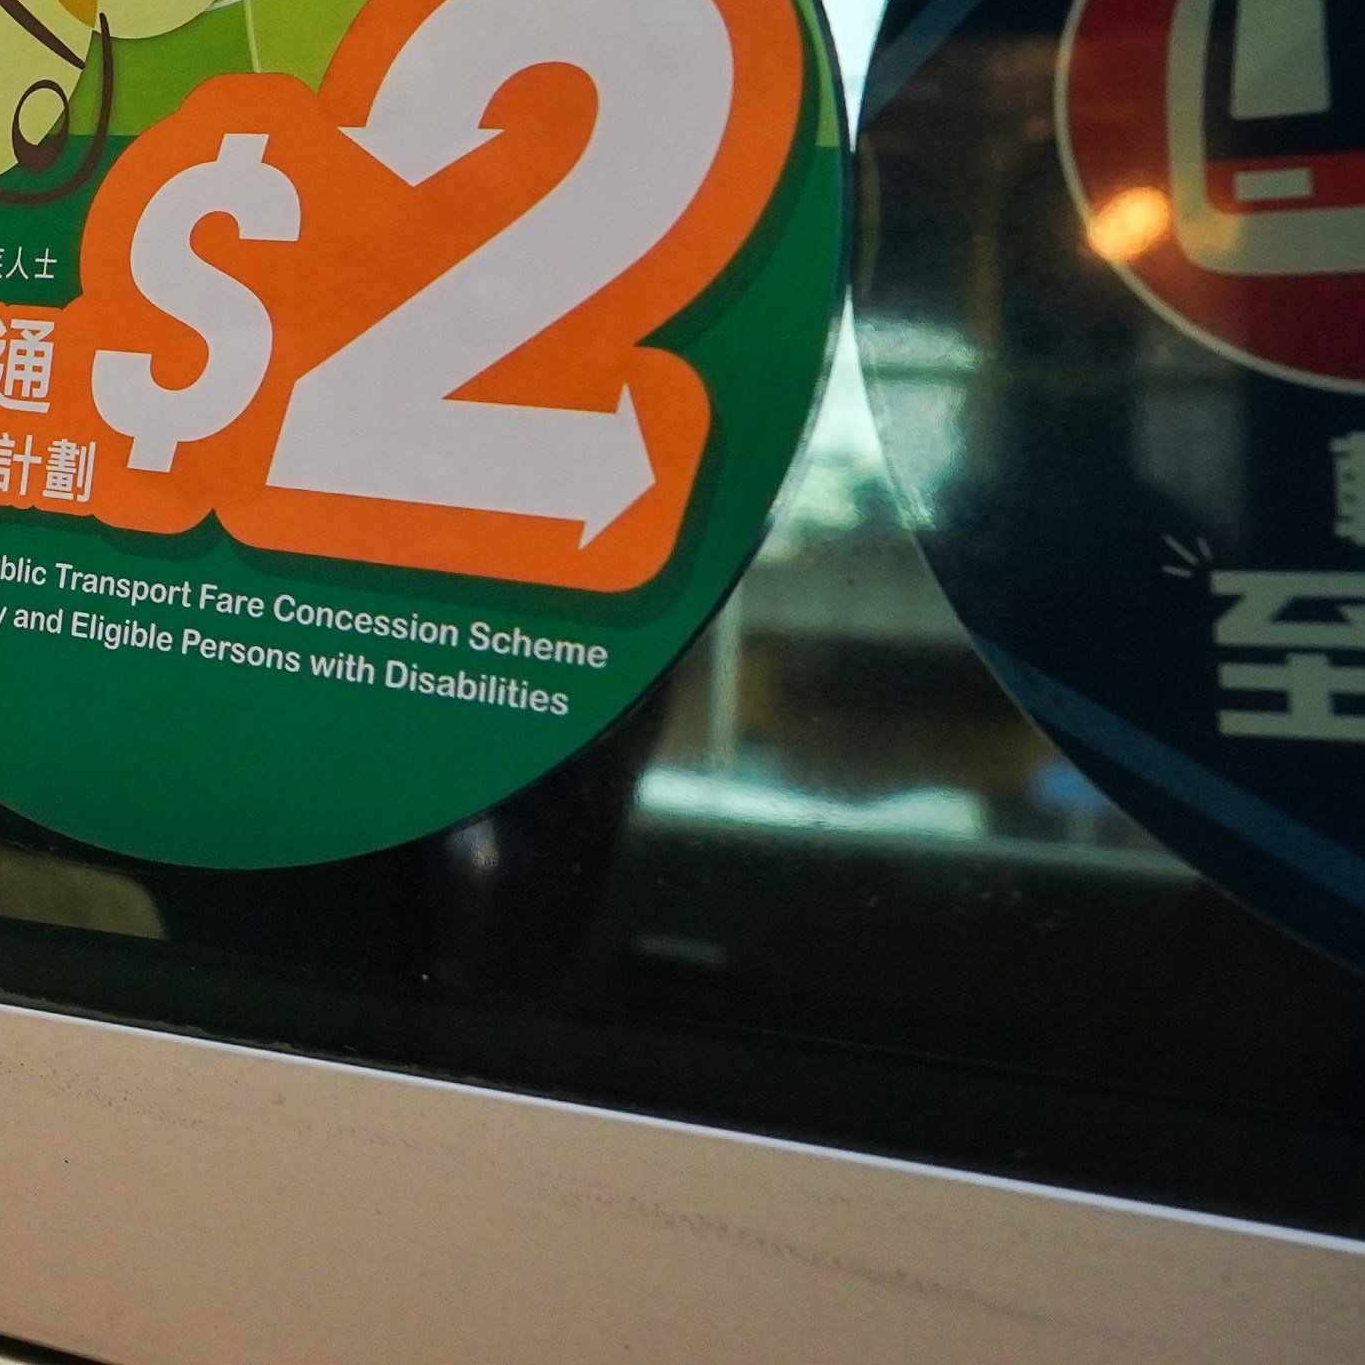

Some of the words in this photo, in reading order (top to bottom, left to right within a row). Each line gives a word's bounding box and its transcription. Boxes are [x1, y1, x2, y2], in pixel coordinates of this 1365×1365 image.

[13, 608, 63, 634] and
[71, 611, 173, 651] Eligible
[181, 628, 301, 673] Persons
[310, 651, 374, 685] with
[384, 659, 570, 716] Disabilities
[55, 562, 192, 608] Transport
[199, 582, 265, 618] Fare
[273, 593, 459, 647] Concession
[468, 621, 609, 669] Scheme
